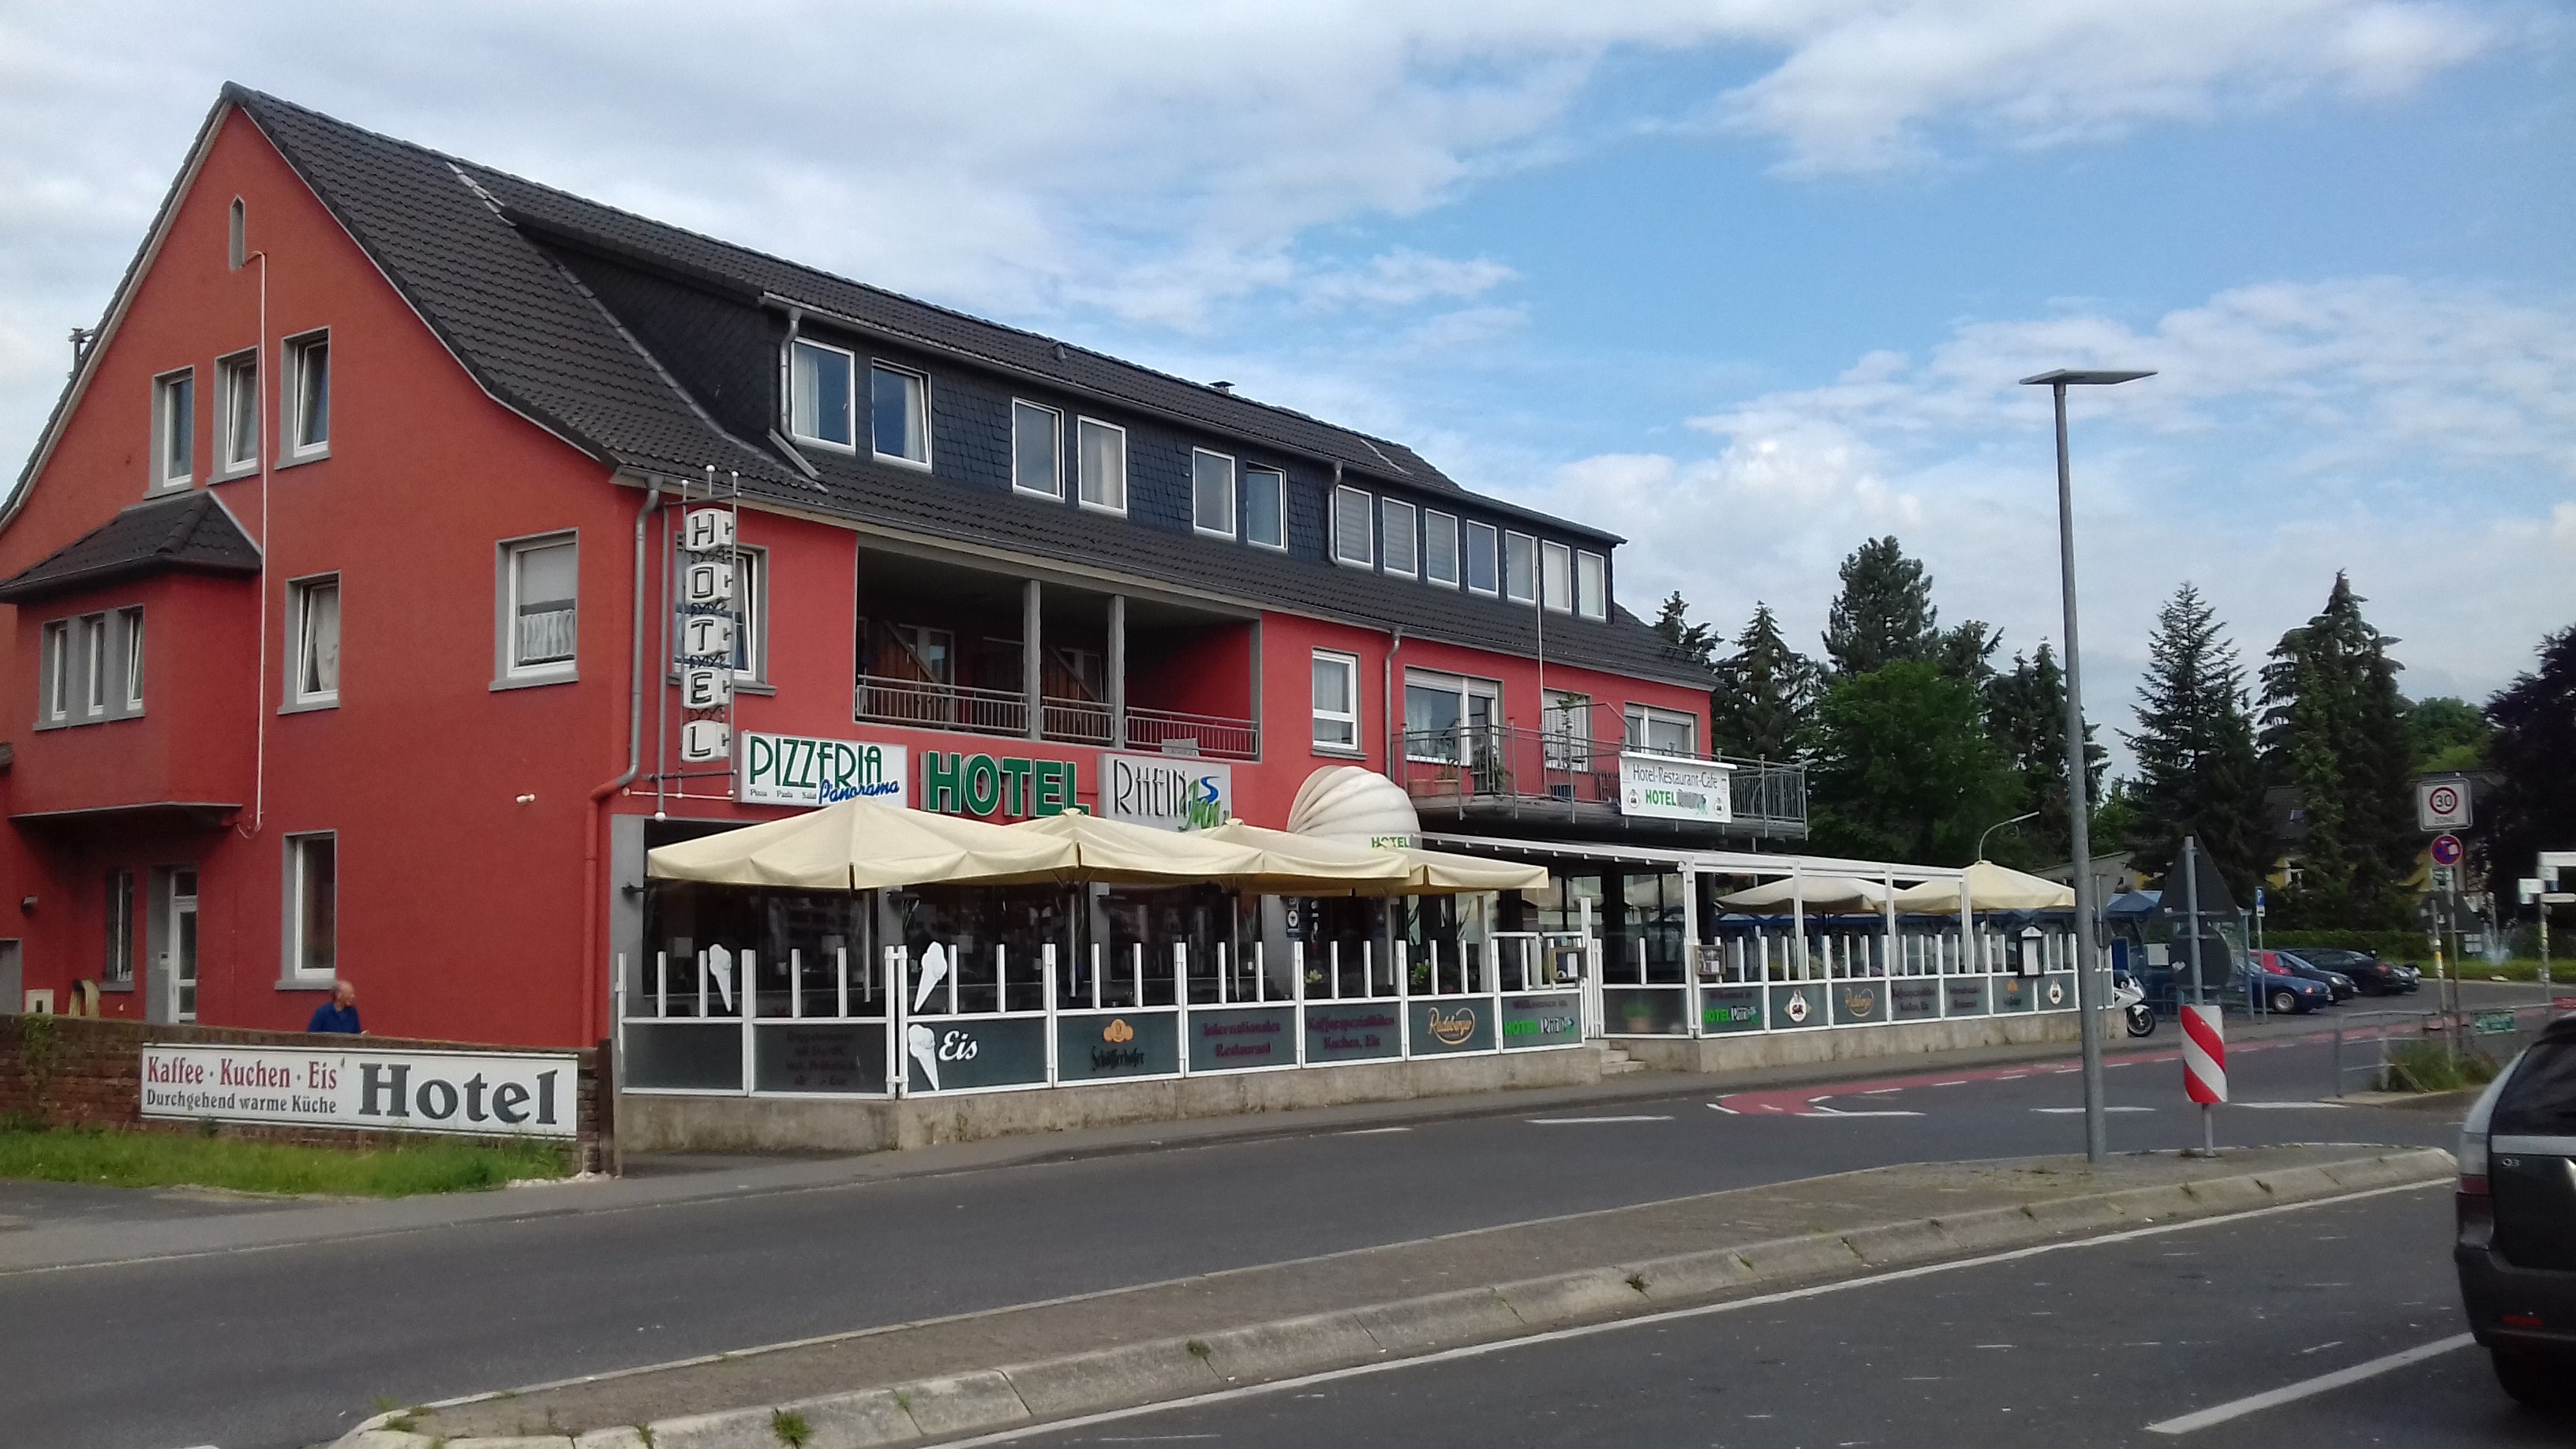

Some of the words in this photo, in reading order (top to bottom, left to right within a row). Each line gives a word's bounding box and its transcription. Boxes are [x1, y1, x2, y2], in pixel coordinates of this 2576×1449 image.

[689, 513, 715, 758] HOTEL
[750, 736, 882, 788] PIZZERIA
[818, 779, 900, 804] Panorama
[927, 751, 1091, 817] HOTEL
[1114, 759, 1189, 818] RHEIN
[1646, 788, 1676, 807] HOTEL
[2436, 795, 2451, 807] 30
[938, 1030, 979, 1061] Eis
[148, 1056, 204, 1084] Kaffee
[219, 1058, 291, 1088] Kuchen
[308, 1061, 338, 1089] Eis
[147, 1088, 235, 1111] Durchgehend
[239, 1094, 287, 1112] warme
[291, 1095, 337, 1114] Küche
[358, 1062, 558, 1125] Hotel
